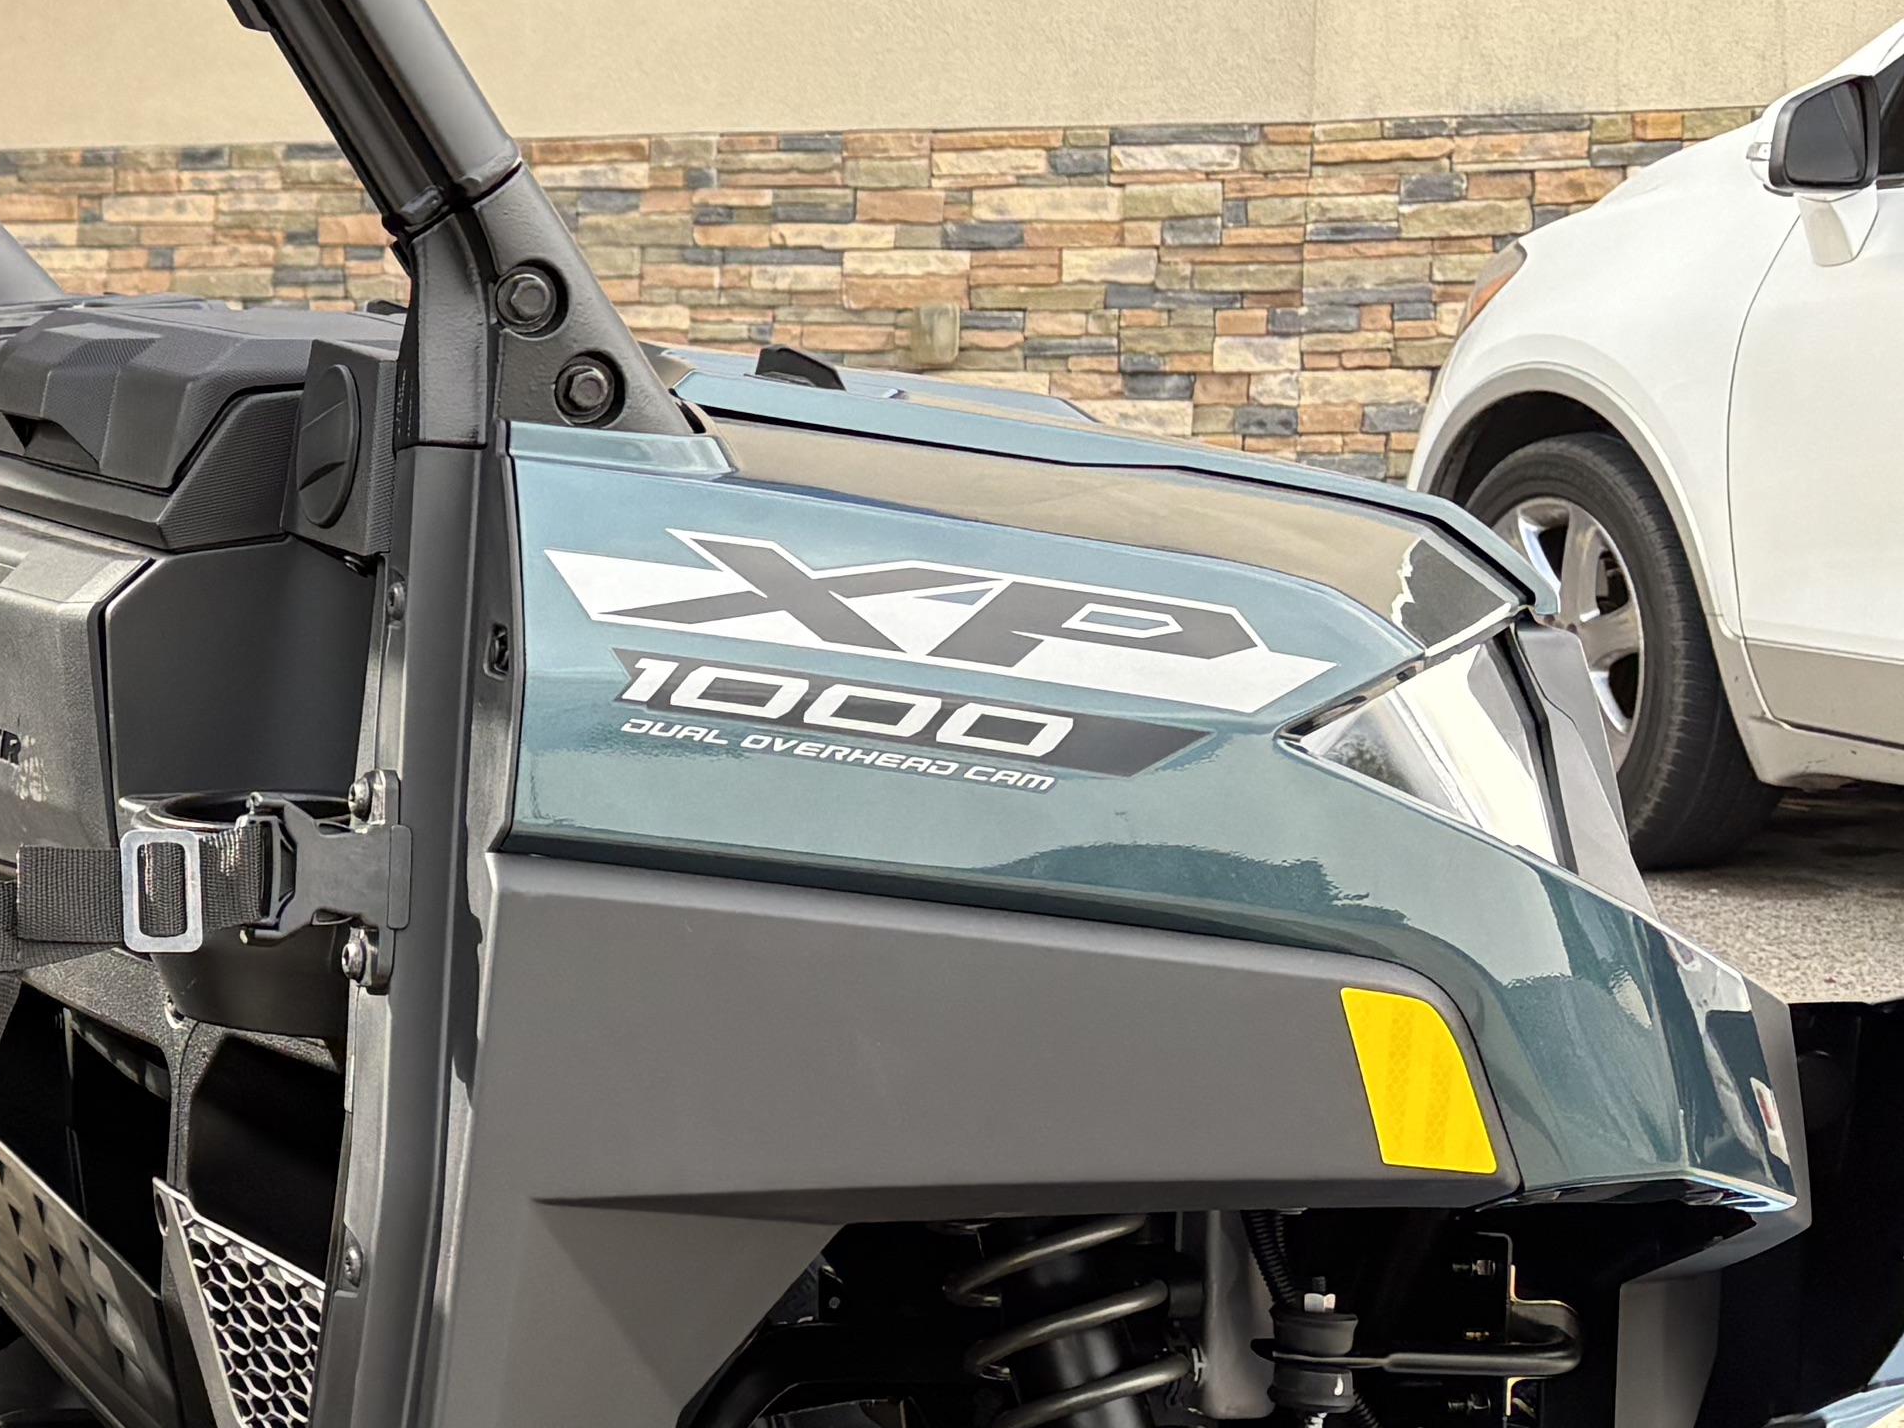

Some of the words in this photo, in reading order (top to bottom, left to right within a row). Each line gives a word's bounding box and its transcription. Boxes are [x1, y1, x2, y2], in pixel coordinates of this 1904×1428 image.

[594, 528, 1269, 668] XP
[620, 718, 728, 745] DUAL
[740, 734, 959, 777] OVERHEAD
[964, 765, 1056, 792] CAM
[623, 657, 1074, 758] 1000
